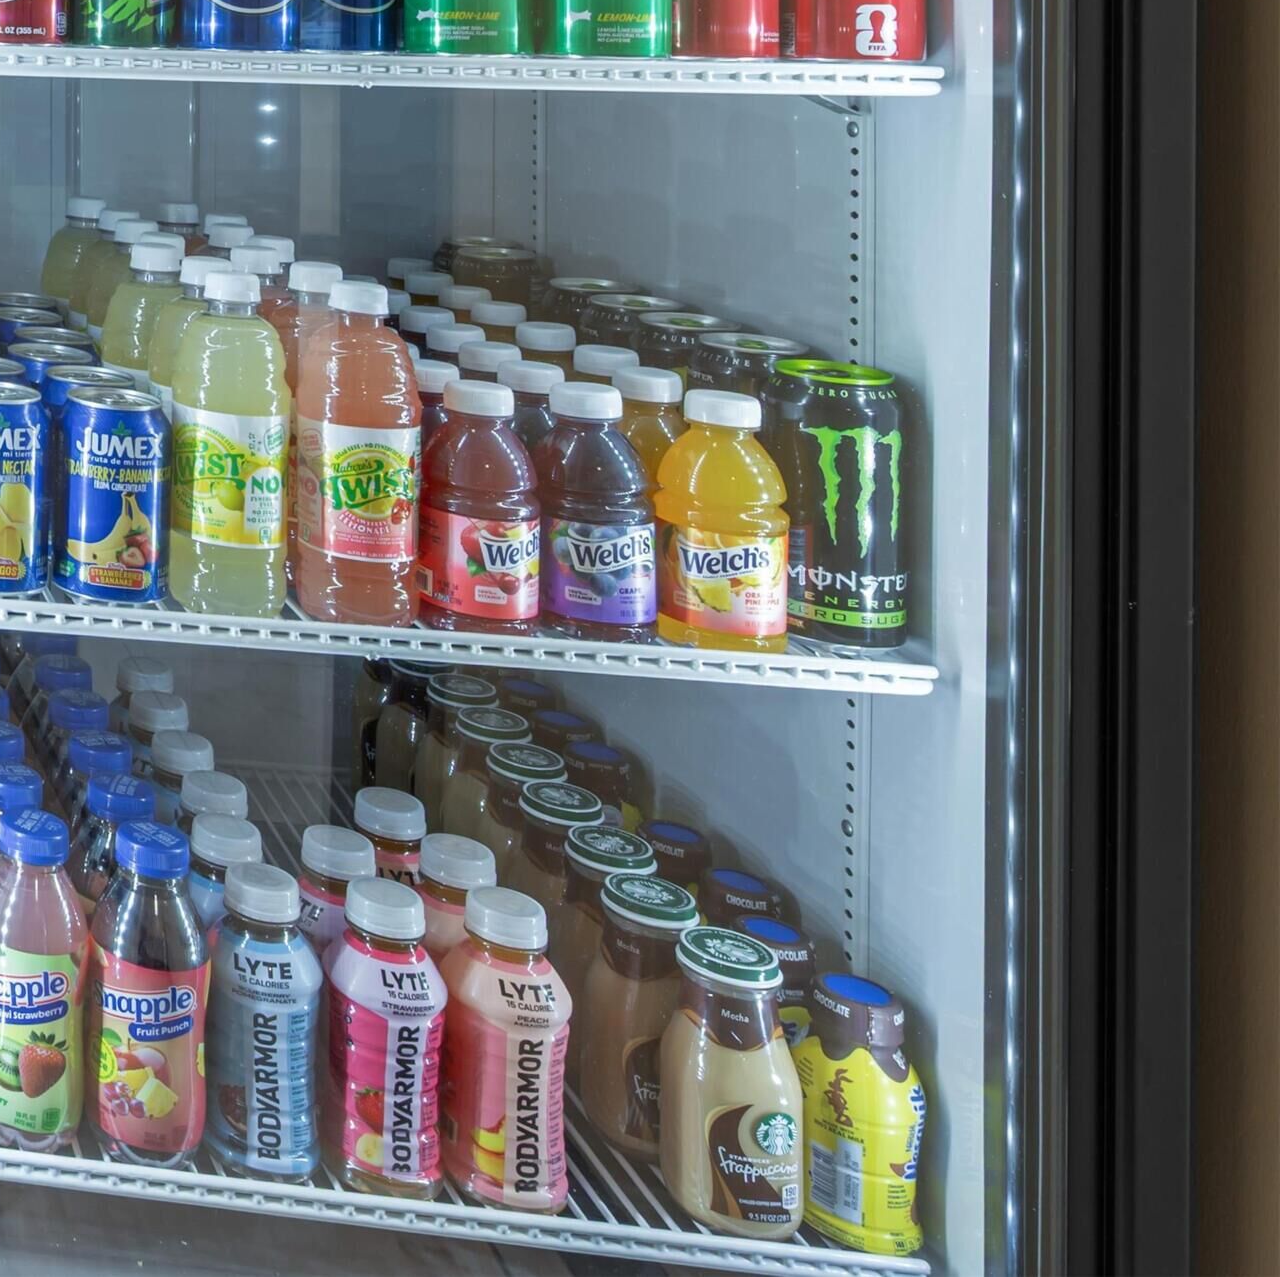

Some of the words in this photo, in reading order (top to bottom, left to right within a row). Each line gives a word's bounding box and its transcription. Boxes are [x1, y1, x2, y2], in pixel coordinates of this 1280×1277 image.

[1, 449, 14, 457] mi
[76, 426, 163, 459] JUMEX
[570, 531, 652, 568] Welch's
[679, 546, 771, 576] Welch's
[803, 589, 905, 610] ENERGY
[726, 892, 768, 912] CHOCOLATE
[233, 952, 294, 981] LYTE
[380, 969, 430, 992] LYTE
[498, 978, 557, 1003] LYTE
[381, 1001, 436, 1014] STRAWBERRY
[387, 990, 397, 1001] 15
[397, 991, 431, 1002] CALORIES
[813, 988, 851, 1019] CHOCOLATE
[516, 1015, 550, 1025] PEACH
[720, 1007, 751, 1024] Mocha
[135, 1024, 159, 1037] Fruit
[160, 1020, 190, 1034] Punch
[253, 1012, 282, 1162] BODYARMOR
[391, 1025, 421, 1174] BODYARMOR
[514, 1038, 544, 1194] BODYARMOR
[719, 1145, 799, 1184] frappuccino
